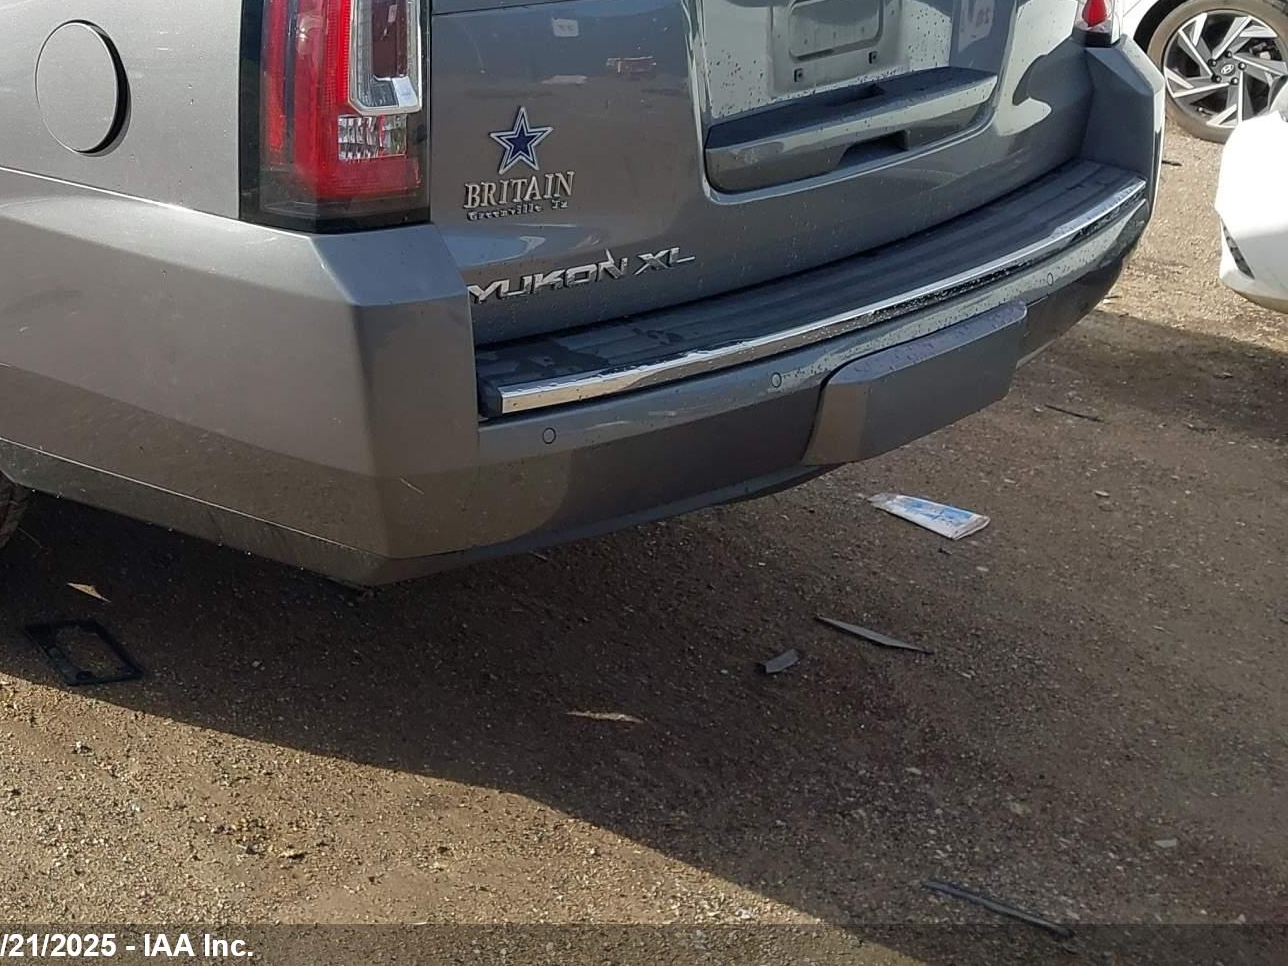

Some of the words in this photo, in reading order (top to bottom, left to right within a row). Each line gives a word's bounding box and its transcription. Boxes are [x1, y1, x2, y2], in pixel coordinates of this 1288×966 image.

[463, 171, 575, 209] BRITAIN
[467, 202, 542, 221] Greenville
[466, 248, 628, 304] YUKON
[634, 247, 696, 276] XL
